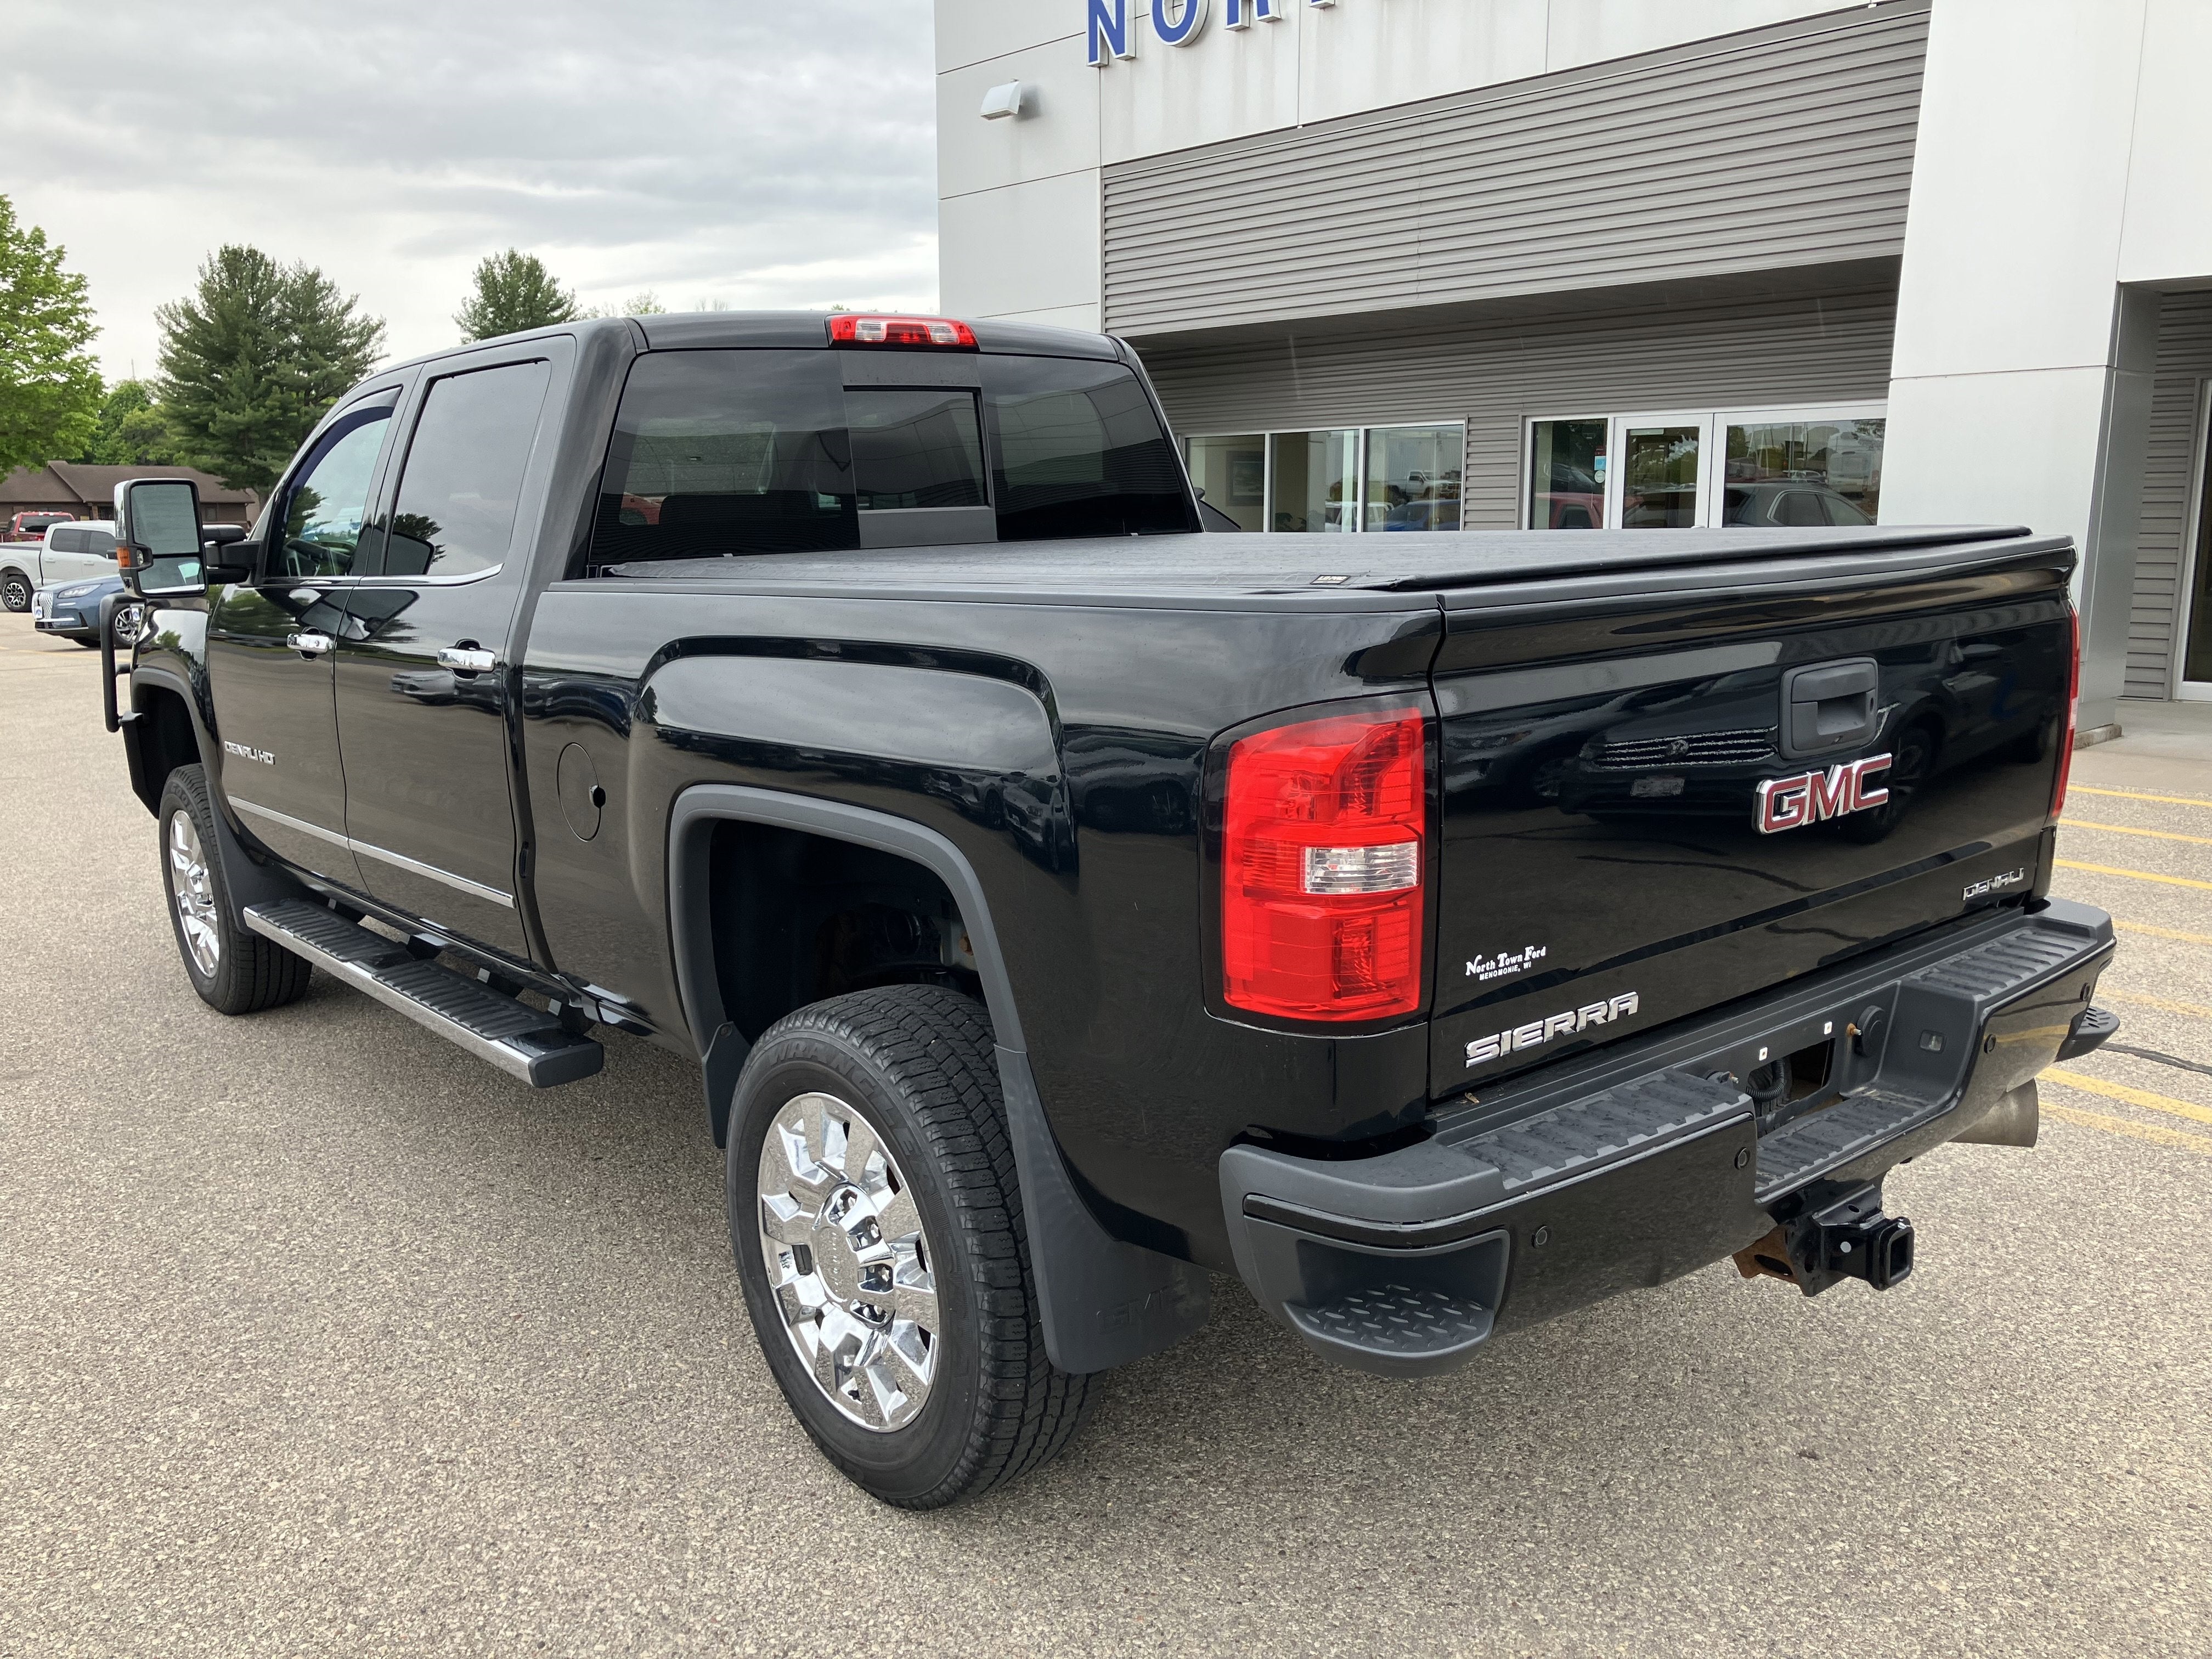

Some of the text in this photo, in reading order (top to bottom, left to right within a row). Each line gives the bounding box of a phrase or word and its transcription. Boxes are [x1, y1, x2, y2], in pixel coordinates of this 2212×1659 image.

[1754, 753, 1892, 834] GMC
[1962, 868, 2024, 901] DENALI
[1465, 945, 1546, 976] North Town Ford
[1479, 961, 1532, 981] MENOMONIE, WI
[1464, 991, 1639, 1068] SIERRA
